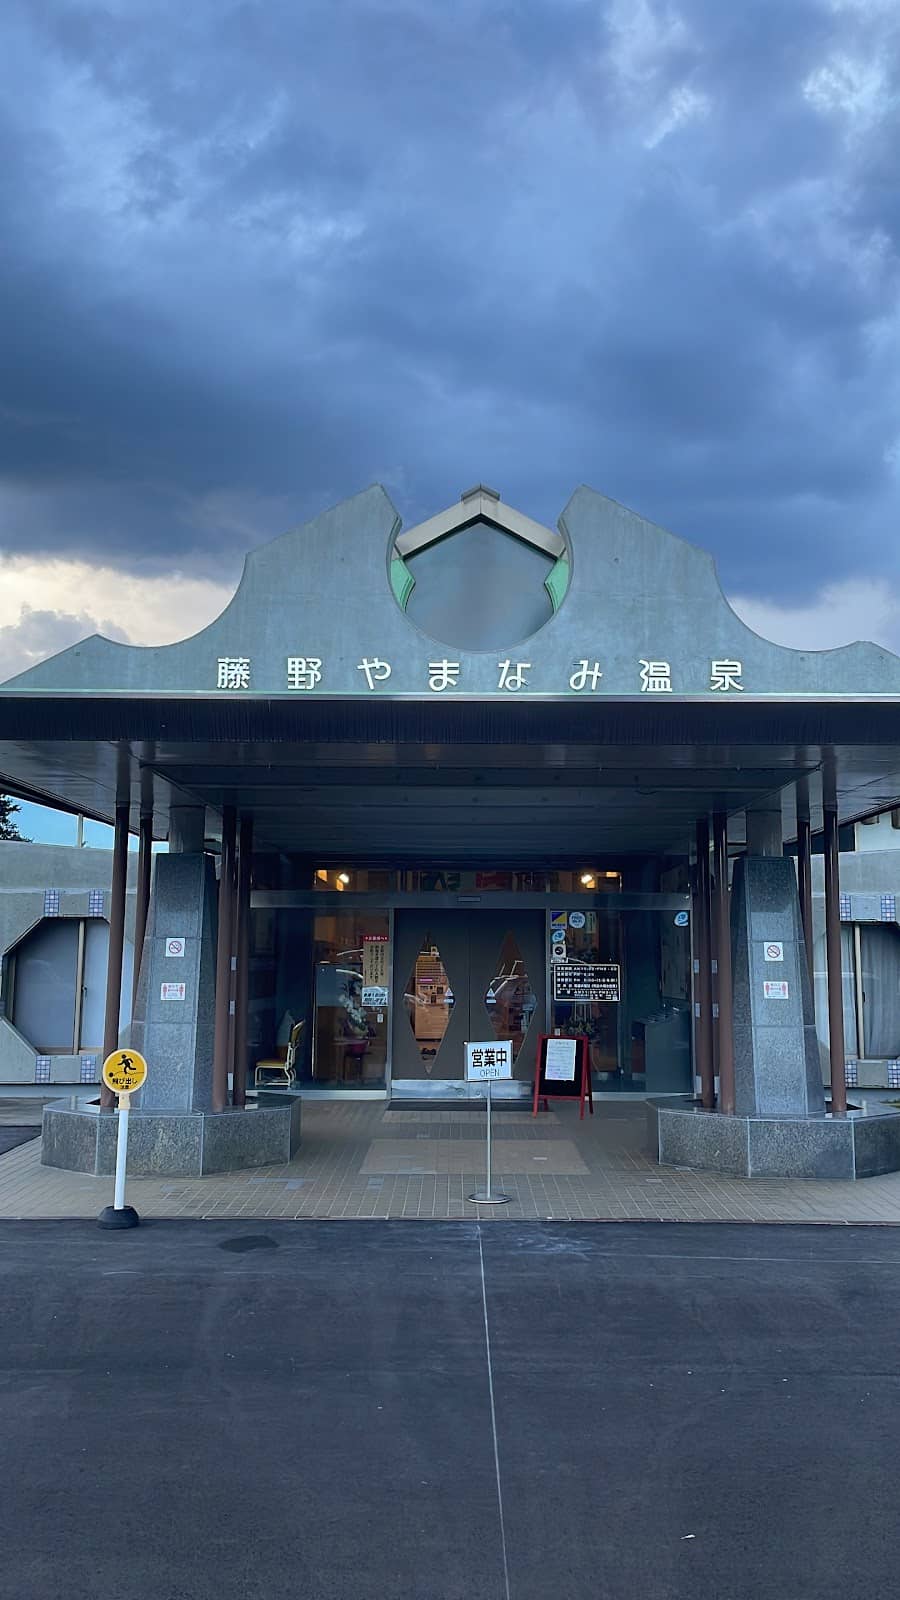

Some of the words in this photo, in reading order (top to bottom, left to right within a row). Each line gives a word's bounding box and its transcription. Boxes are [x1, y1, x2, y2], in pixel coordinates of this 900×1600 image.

[216, 657, 744, 692] 藤野やまなみ温泉
[471, 1047, 507, 1067] 営業中
[480, 1069, 500, 1077] OPEN
